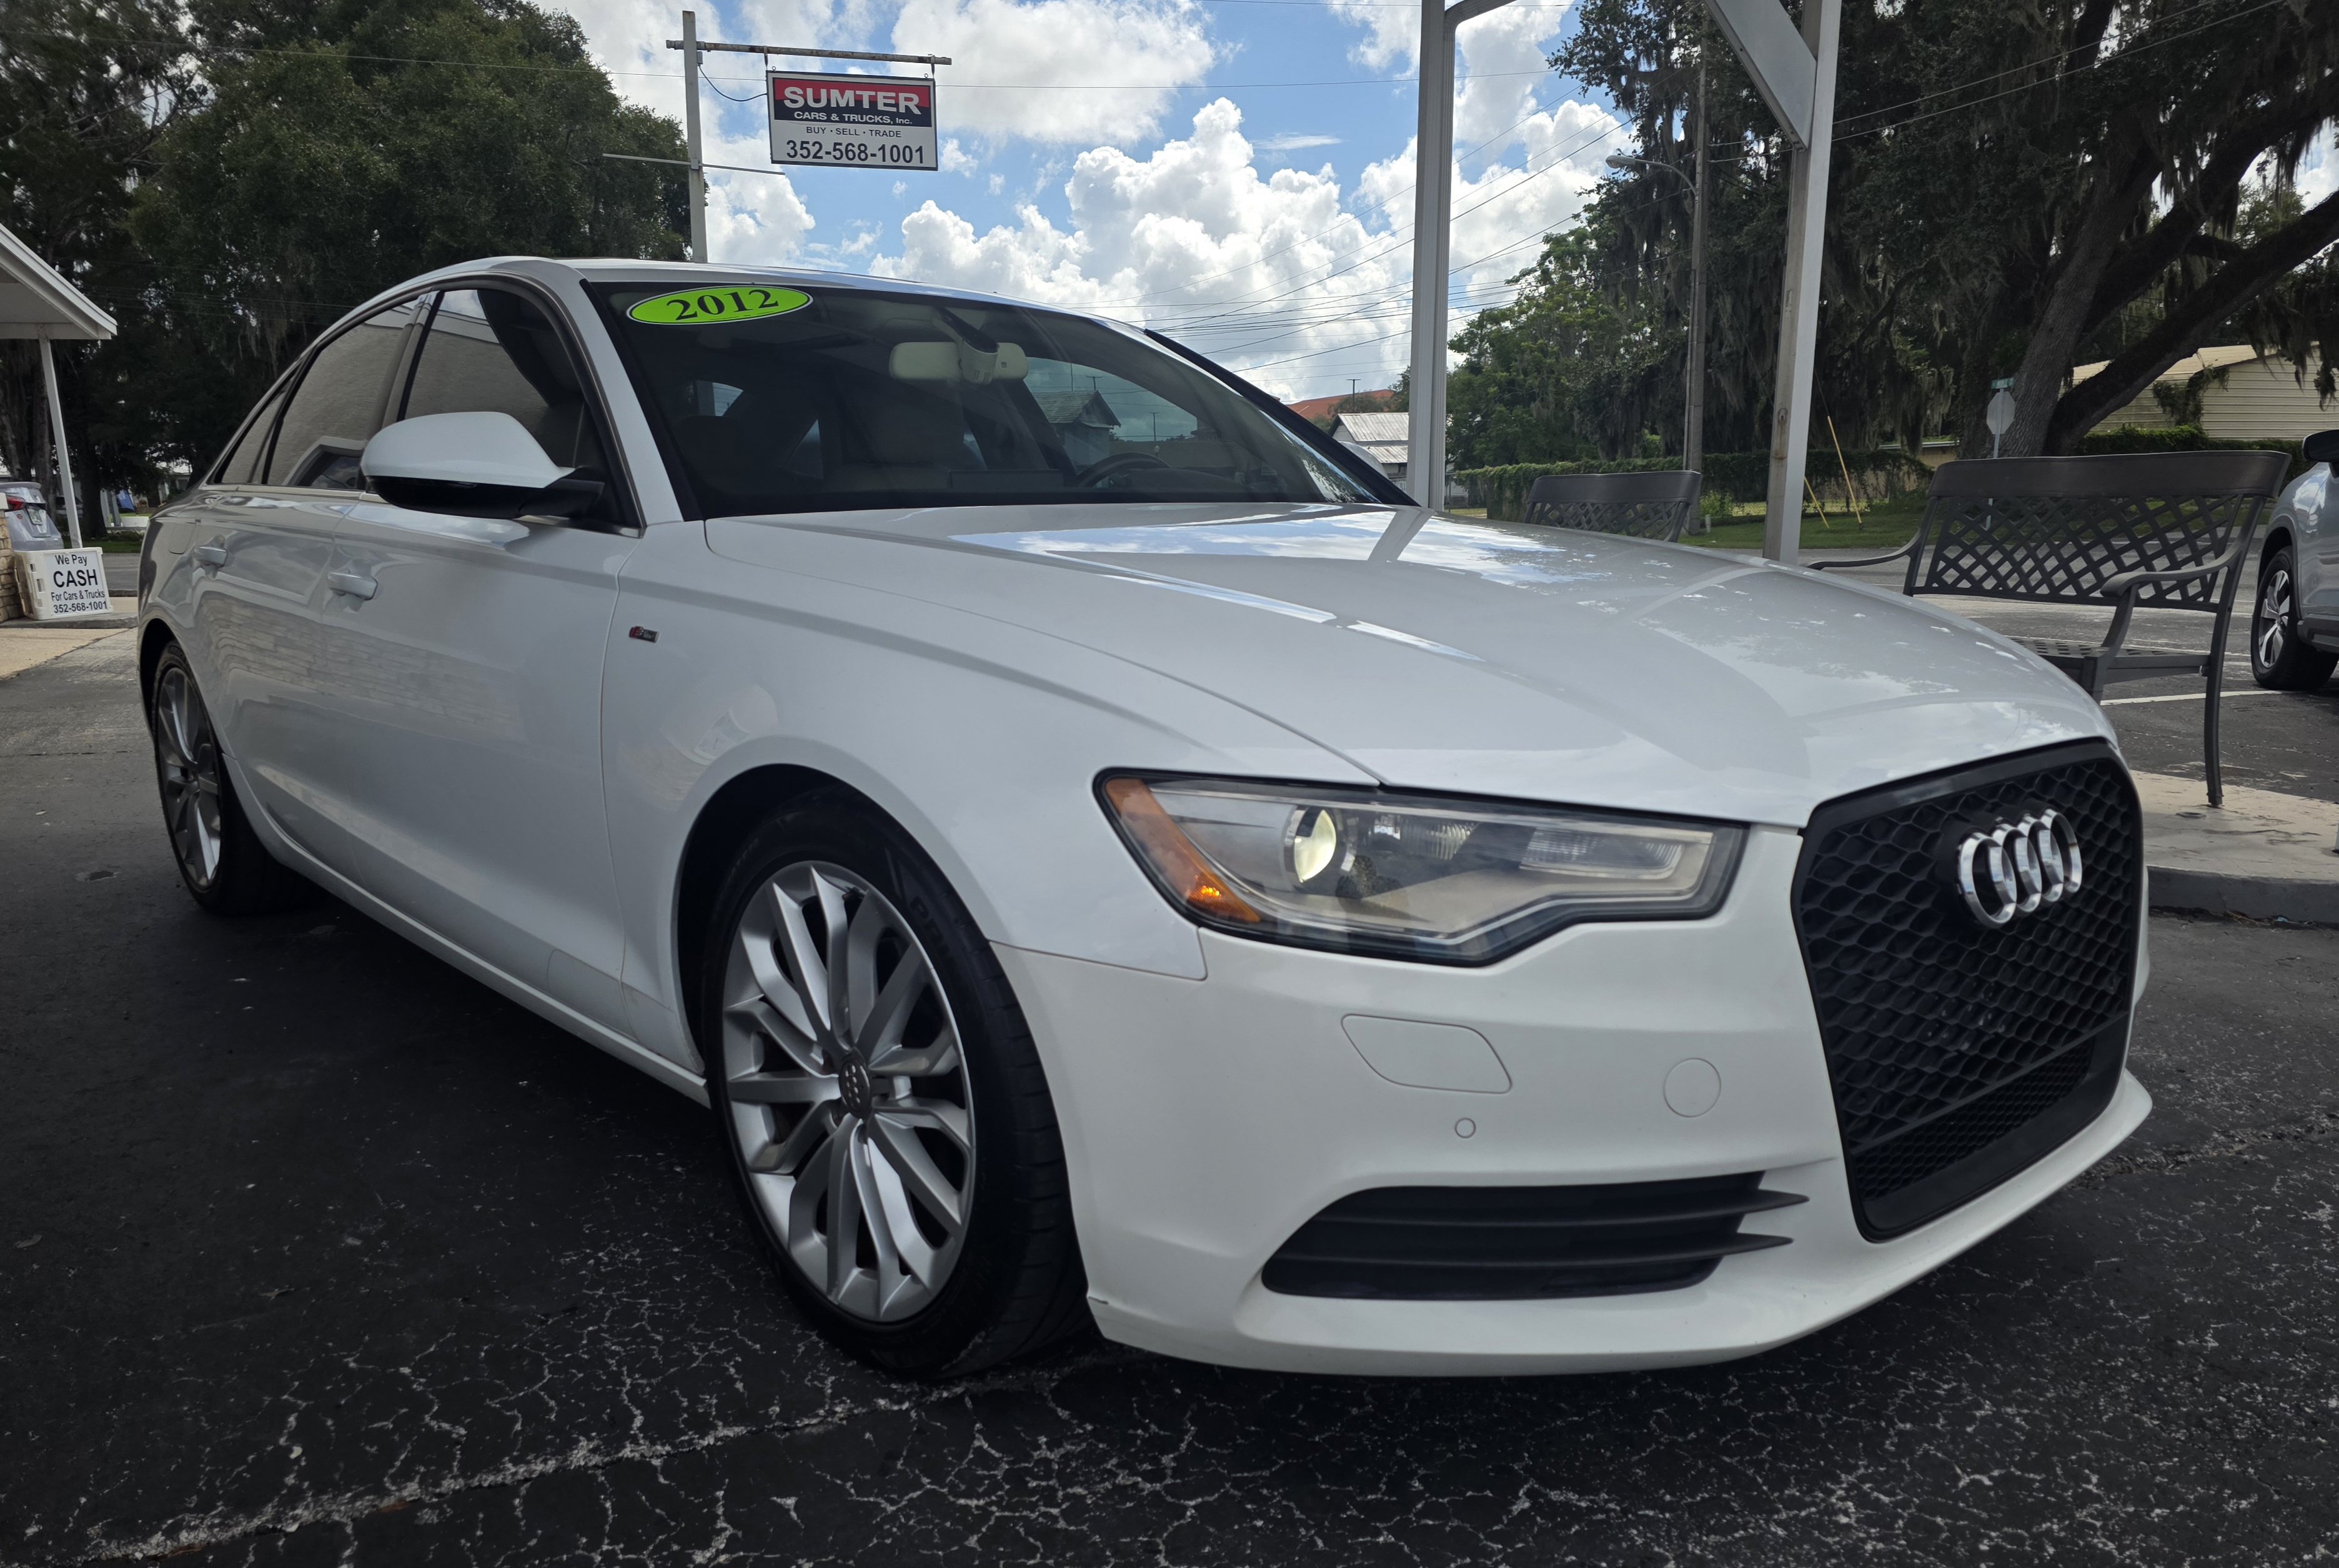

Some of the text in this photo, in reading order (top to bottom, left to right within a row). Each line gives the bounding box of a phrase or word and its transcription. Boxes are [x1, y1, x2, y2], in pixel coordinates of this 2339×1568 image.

[783, 87, 921, 115] SUMTER
[794, 111, 828, 121] CARS
[830, 113, 840, 121] &
[843, 114, 893, 124] TRUCKS,
[806, 126, 901, 137] BUY SELL TRADE
[786, 139, 923, 164] 352-568-1001
[667, 289, 779, 320] 2012
[54, 554, 87, 566] We Pay
[53, 569, 98, 588] CASH
[51, 588, 105, 602] For Cars & Trucks
[53, 600, 107, 613] 352-568-1001
